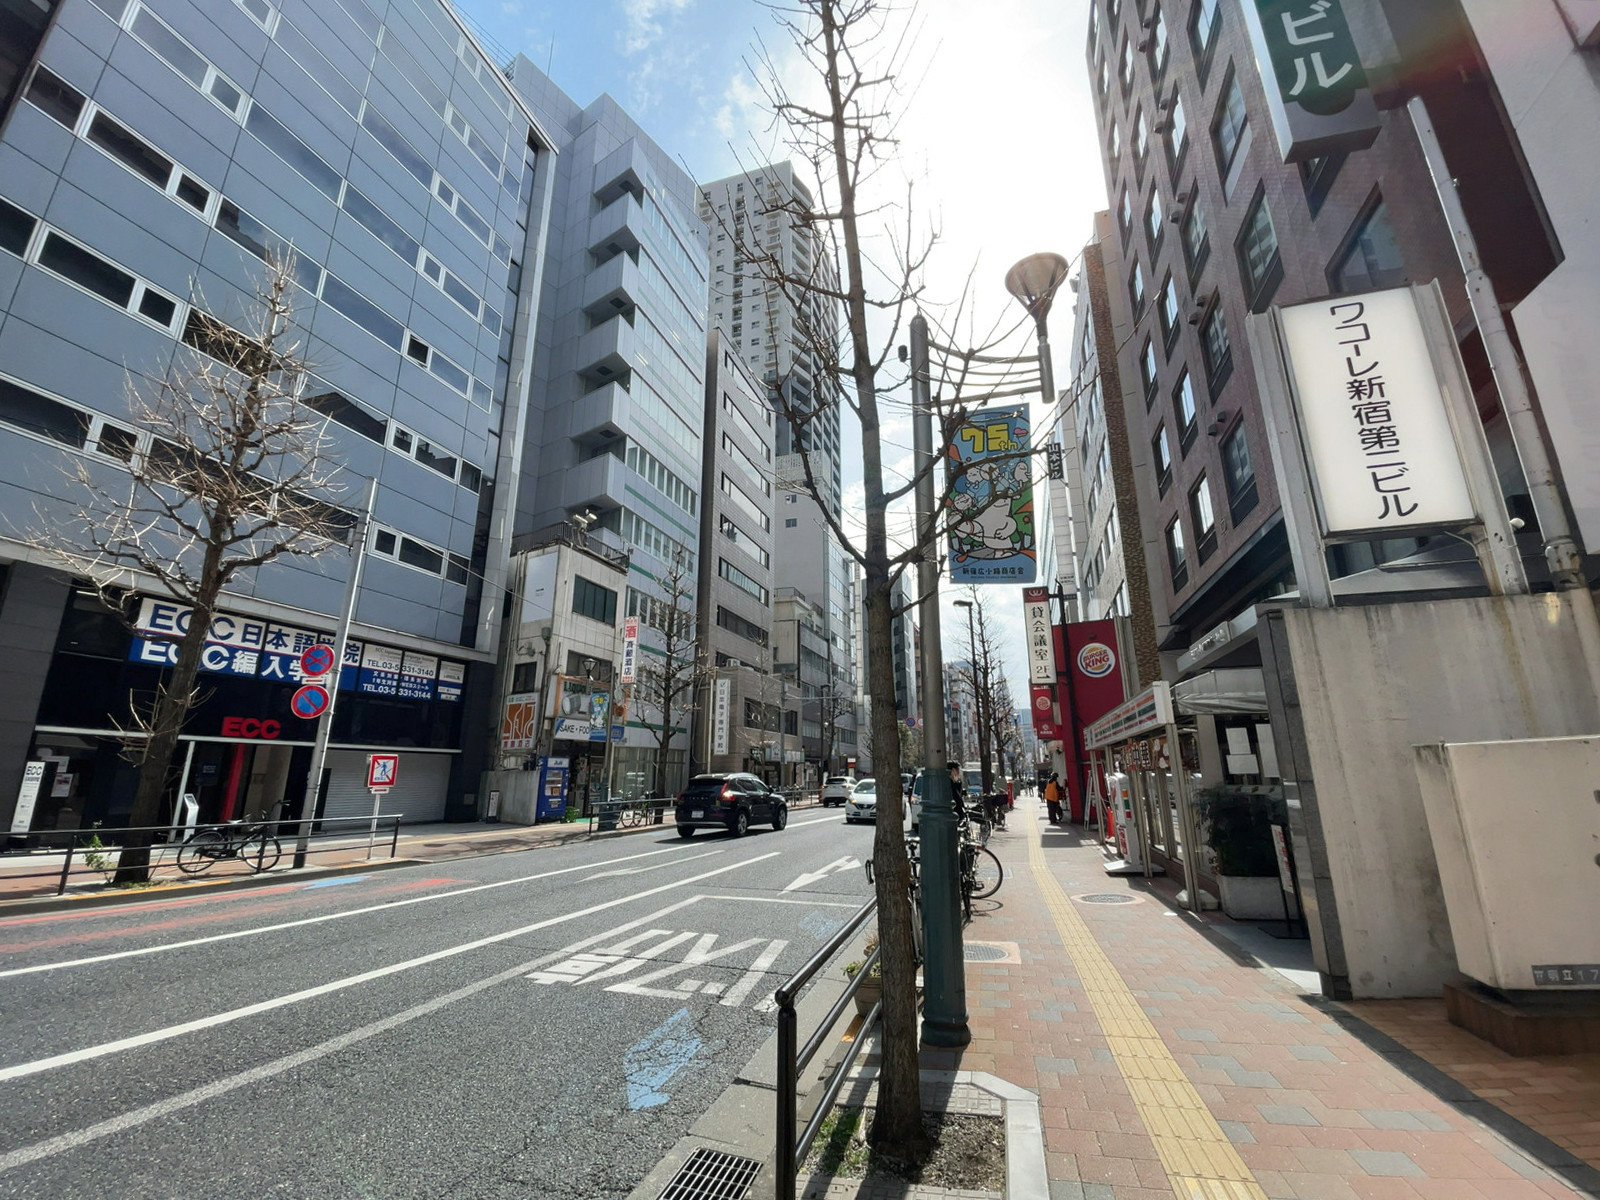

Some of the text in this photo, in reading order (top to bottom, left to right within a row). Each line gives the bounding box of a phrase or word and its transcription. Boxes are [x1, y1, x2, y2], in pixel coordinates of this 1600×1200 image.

[1281, 1, 1353, 97] ビル
[1329, 301, 1418, 521] ワコーレ新宿第二ビル
[961, 423, 1018, 453] 75th
[1031, 606, 1048, 661] 貸会議室
[1036, 666, 1050, 674] 2F
[1084, 655, 1109, 669] KING
[221, 716, 281, 740] ECC
